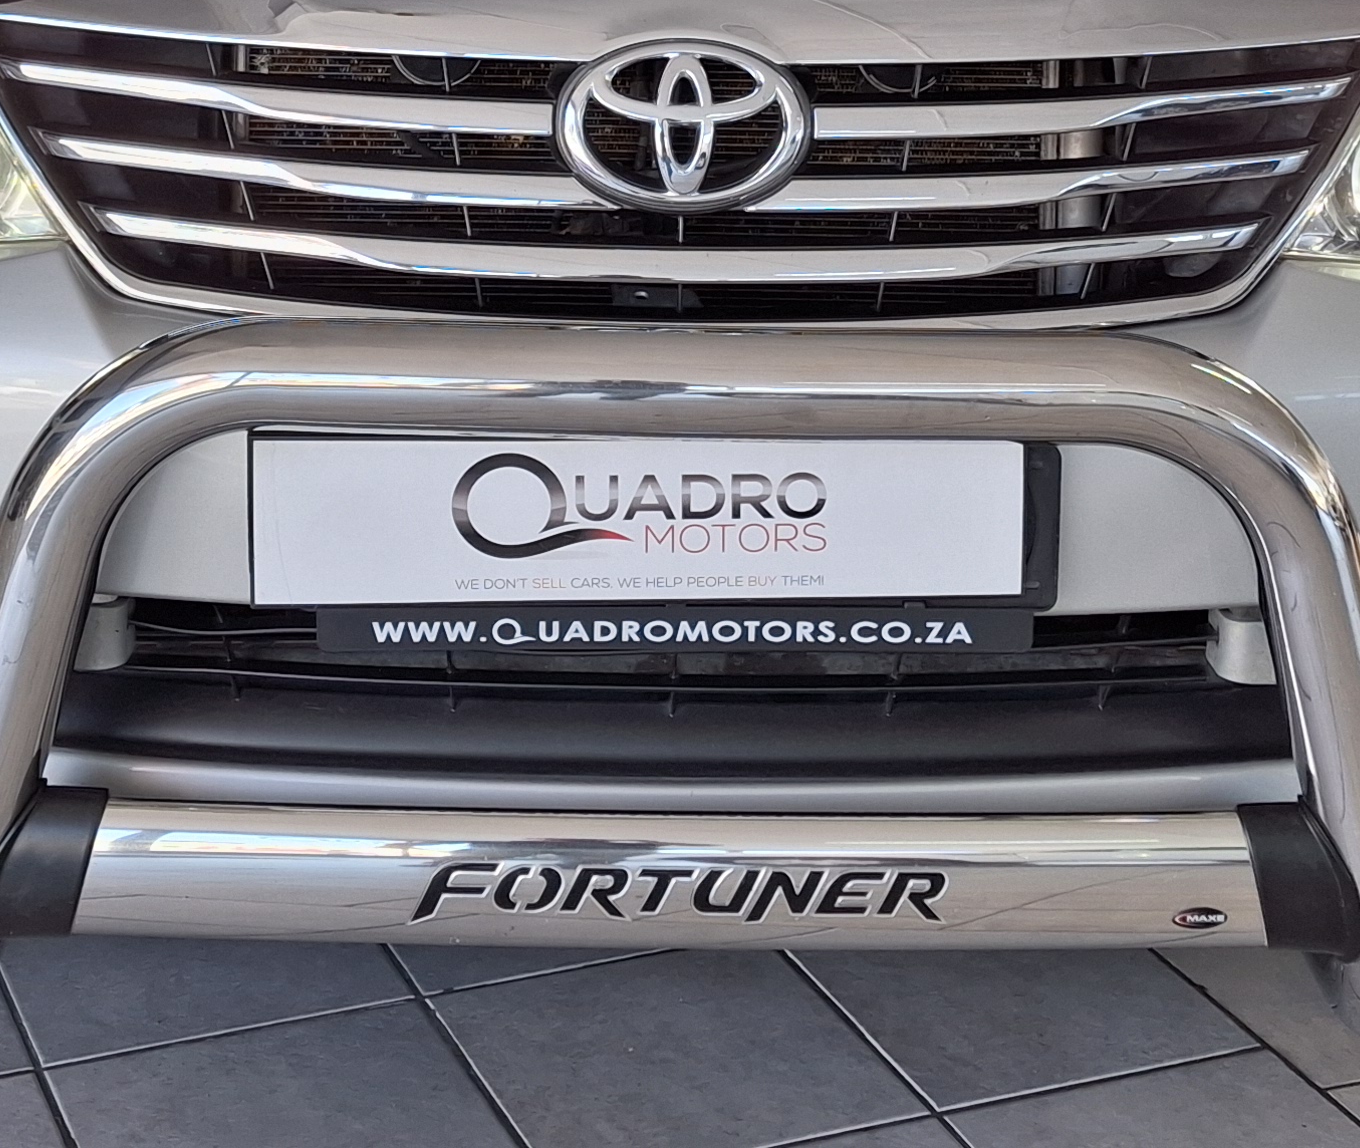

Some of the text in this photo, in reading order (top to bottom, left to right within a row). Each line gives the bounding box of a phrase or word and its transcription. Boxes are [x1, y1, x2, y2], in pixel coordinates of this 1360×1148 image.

[451, 452, 827, 559] QUADRO
[644, 523, 827, 554] MOTORS
[455, 579, 479, 590] WE
[483, 578, 528, 590] DON'T
[532, 578, 566, 589] SELL
[570, 577, 613, 589] CARS.
[618, 577, 642, 589] WE
[645, 576, 683, 588] HELP
[687, 575, 744, 587] PEOPLE
[748, 575, 778, 587] BUY
[371, 617, 973, 644] WWW.QUADROMOTORS.CO.ZA
[406, 861, 949, 925] FORTUNER
